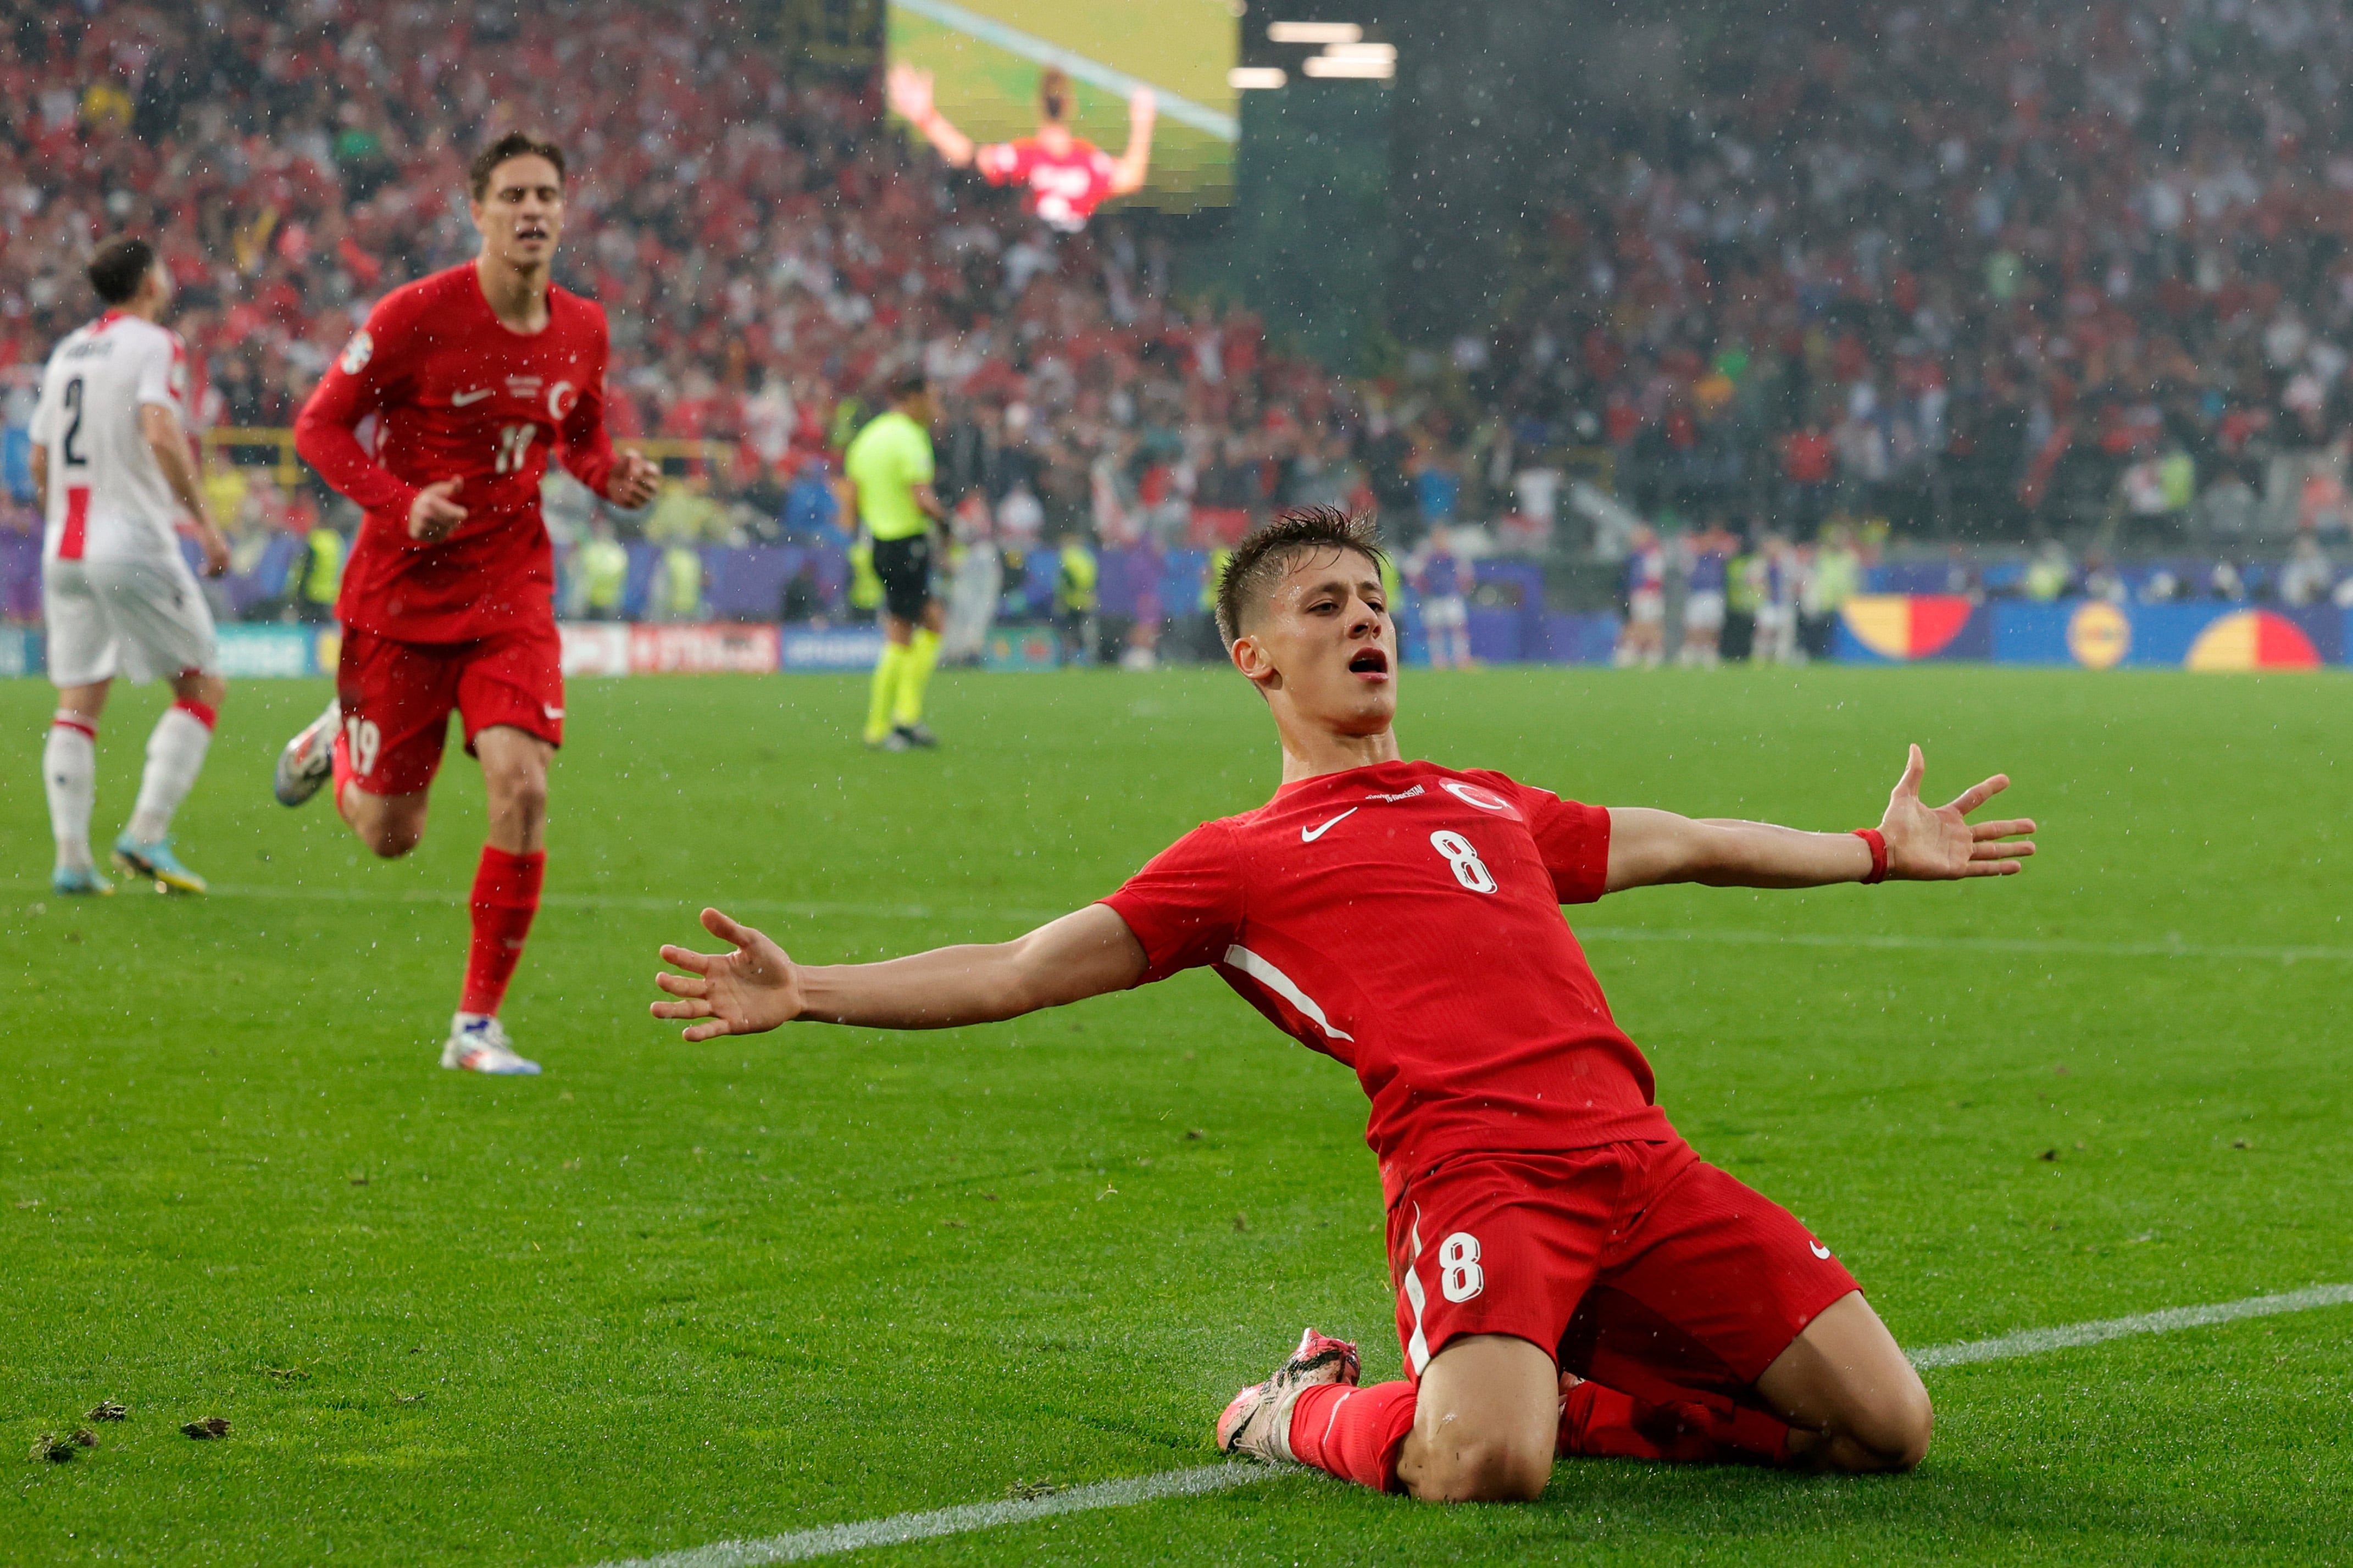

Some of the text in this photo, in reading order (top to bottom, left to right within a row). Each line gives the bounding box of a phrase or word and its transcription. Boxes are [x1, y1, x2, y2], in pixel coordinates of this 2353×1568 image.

[64, 375, 88, 466] 2
[346, 715, 381, 777] 19
[1430, 830, 1498, 894] 8
[1439, 1232, 1485, 1303] 8
